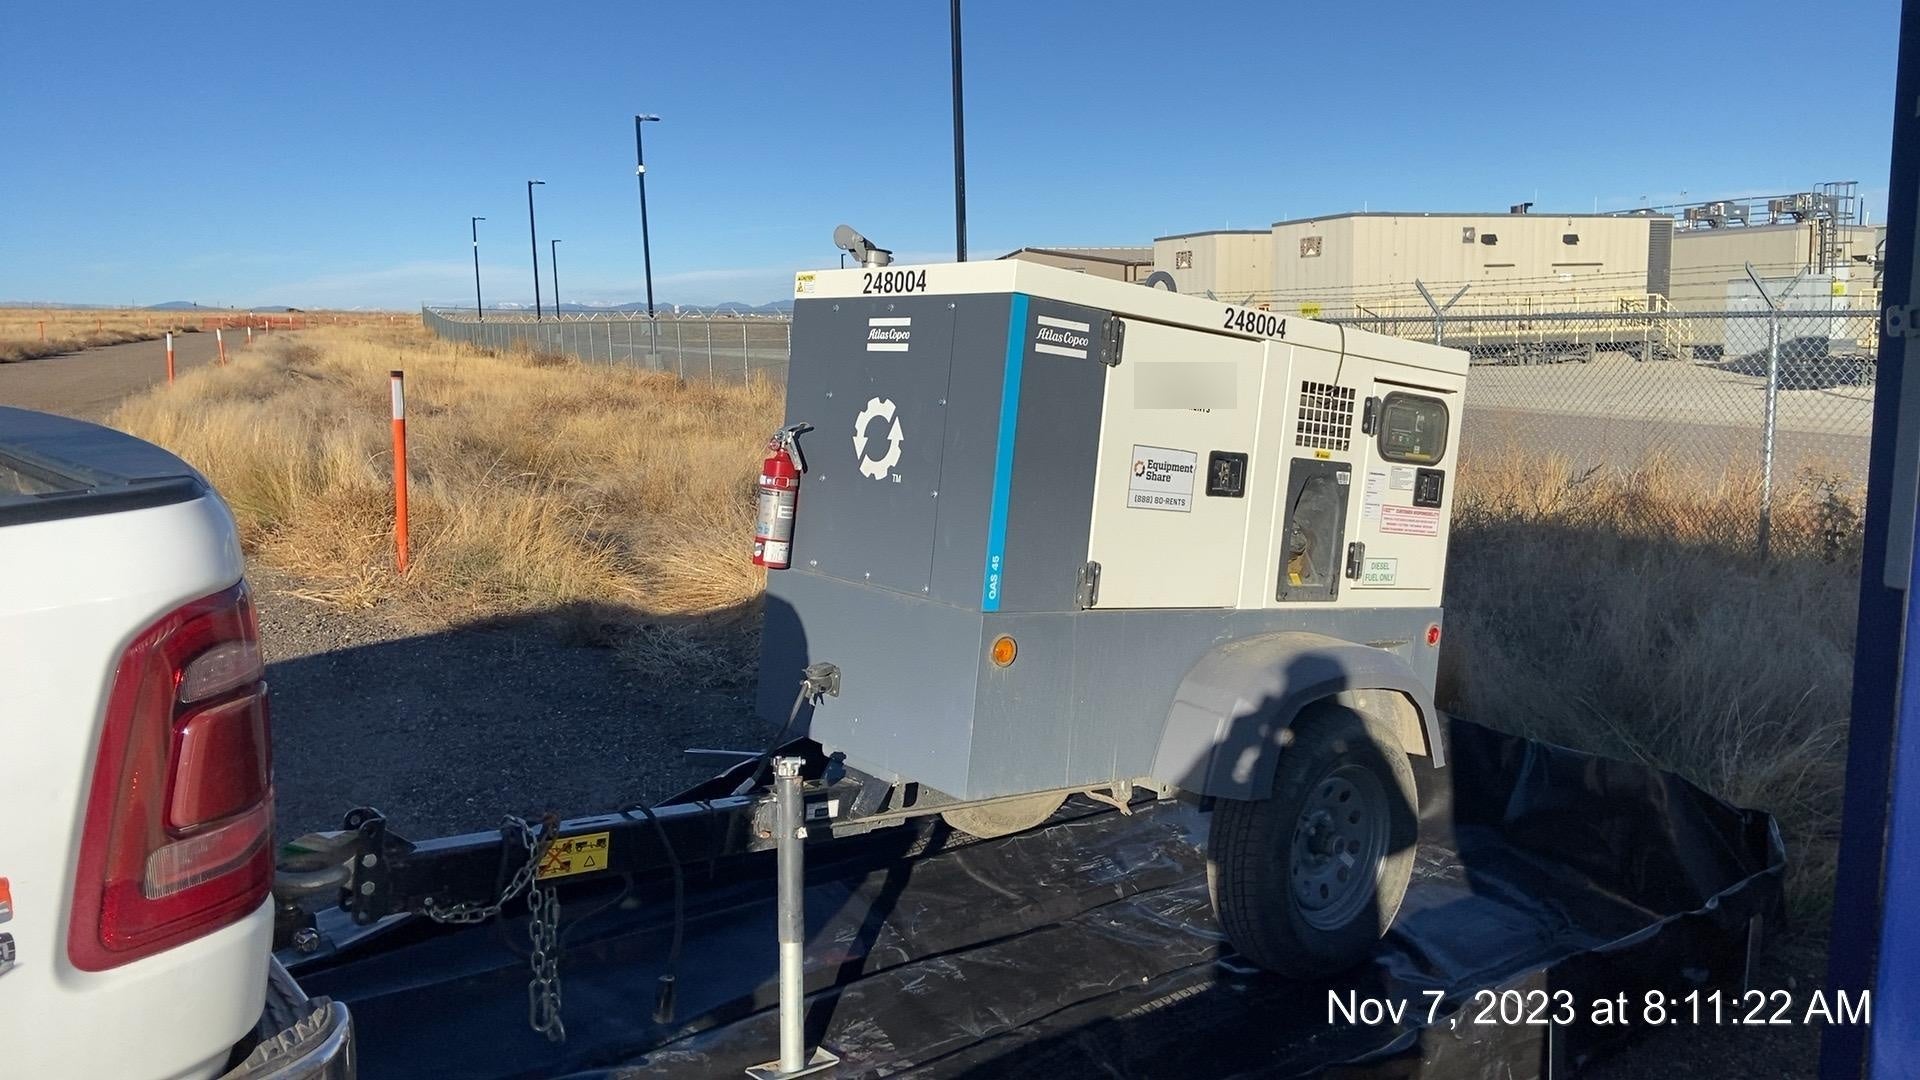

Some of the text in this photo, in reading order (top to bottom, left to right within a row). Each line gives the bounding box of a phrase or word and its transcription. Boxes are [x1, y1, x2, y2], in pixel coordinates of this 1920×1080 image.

[863, 270, 926, 294] 248004
[1224, 307, 1286, 339] 248004
[868, 328, 910, 342] Atlas Copco
[1036, 327, 1089, 347] Atlas Copco
[1147, 459, 1193, 473] Equipment
[1146, 471, 1171, 482] Share
[1135, 495, 1152, 504] (888)
[991, 555, 1000, 571] 45
